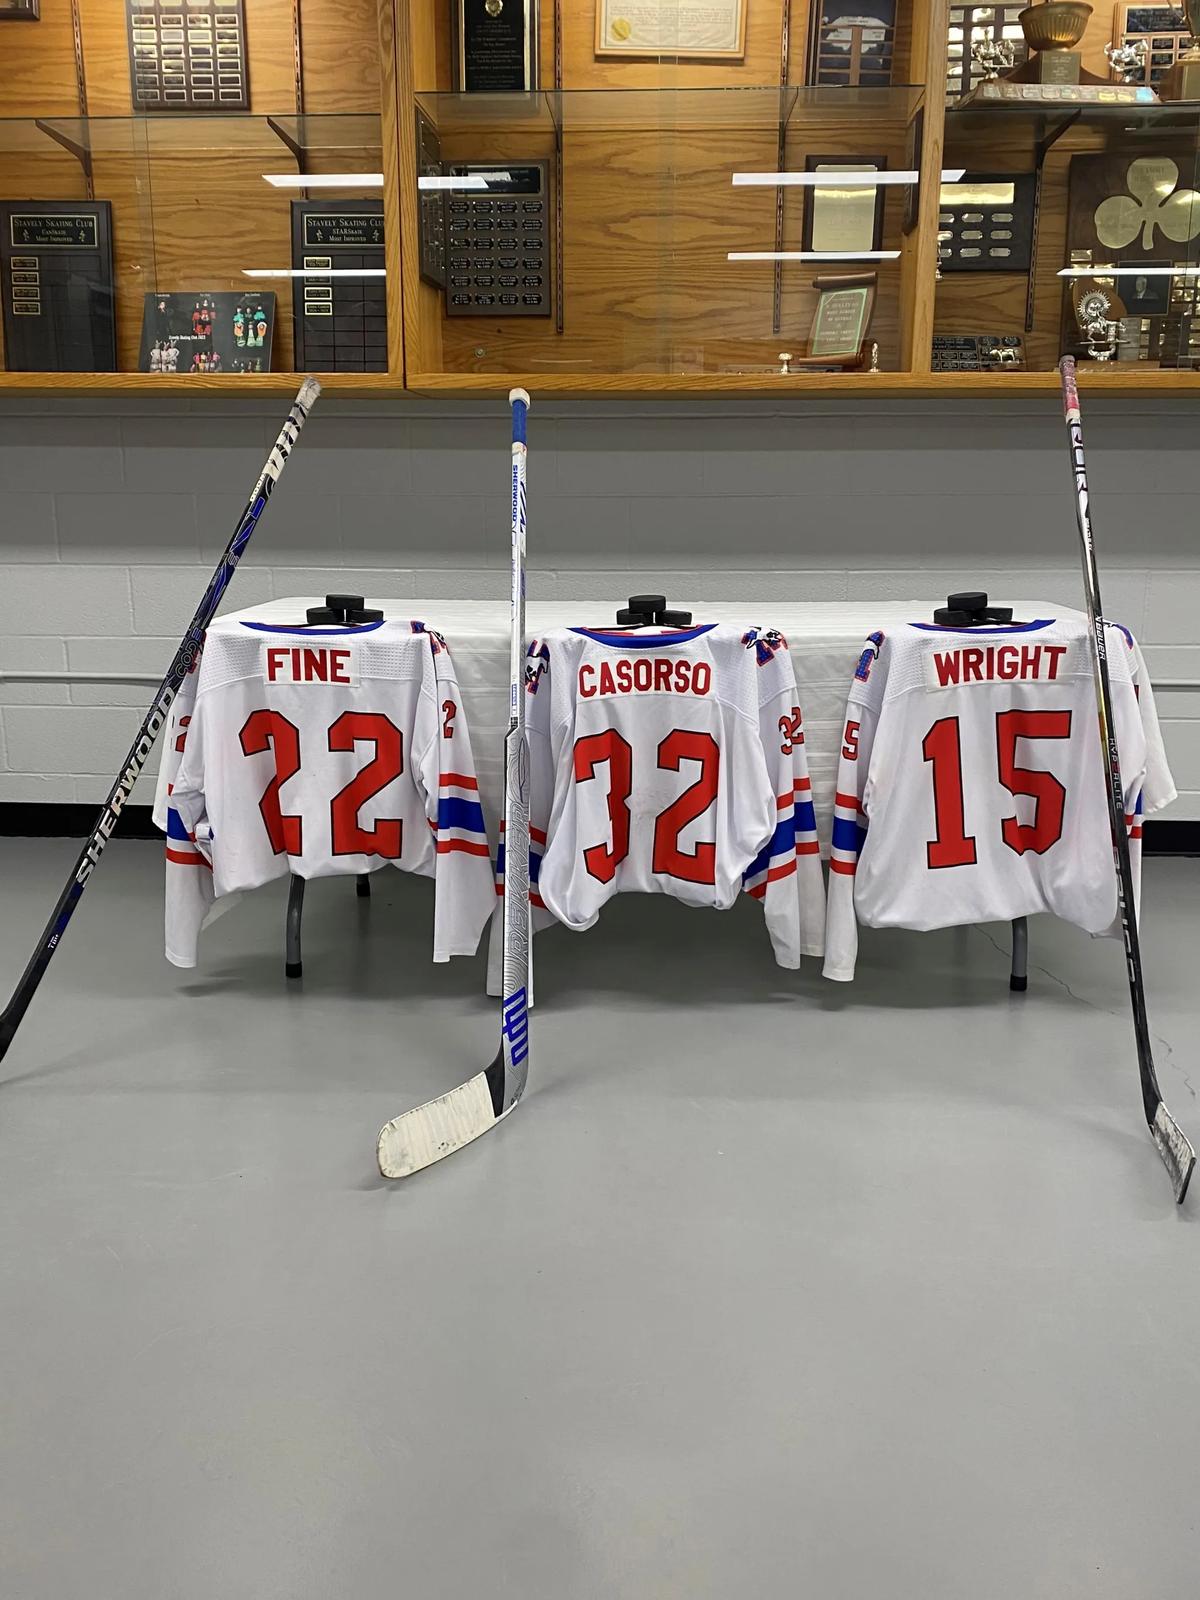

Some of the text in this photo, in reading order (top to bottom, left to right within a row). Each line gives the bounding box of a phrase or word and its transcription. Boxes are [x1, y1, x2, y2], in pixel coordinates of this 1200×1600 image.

[45, 218, 73, 227] SKATING
[75, 219, 93, 227] CLUB
[307, 218, 384, 227] STAVELY SKATING CLU
[267, 647, 351, 684] FINE
[578, 658, 713, 698] CASORSO
[933, 645, 1067, 687] WRIGHT
[778, 705, 805, 756] 32
[75, 685, 174, 888] SHERWOOD
[238, 708, 404, 860] 22
[573, 728, 721, 886] 32
[921, 709, 1073, 870] 15
